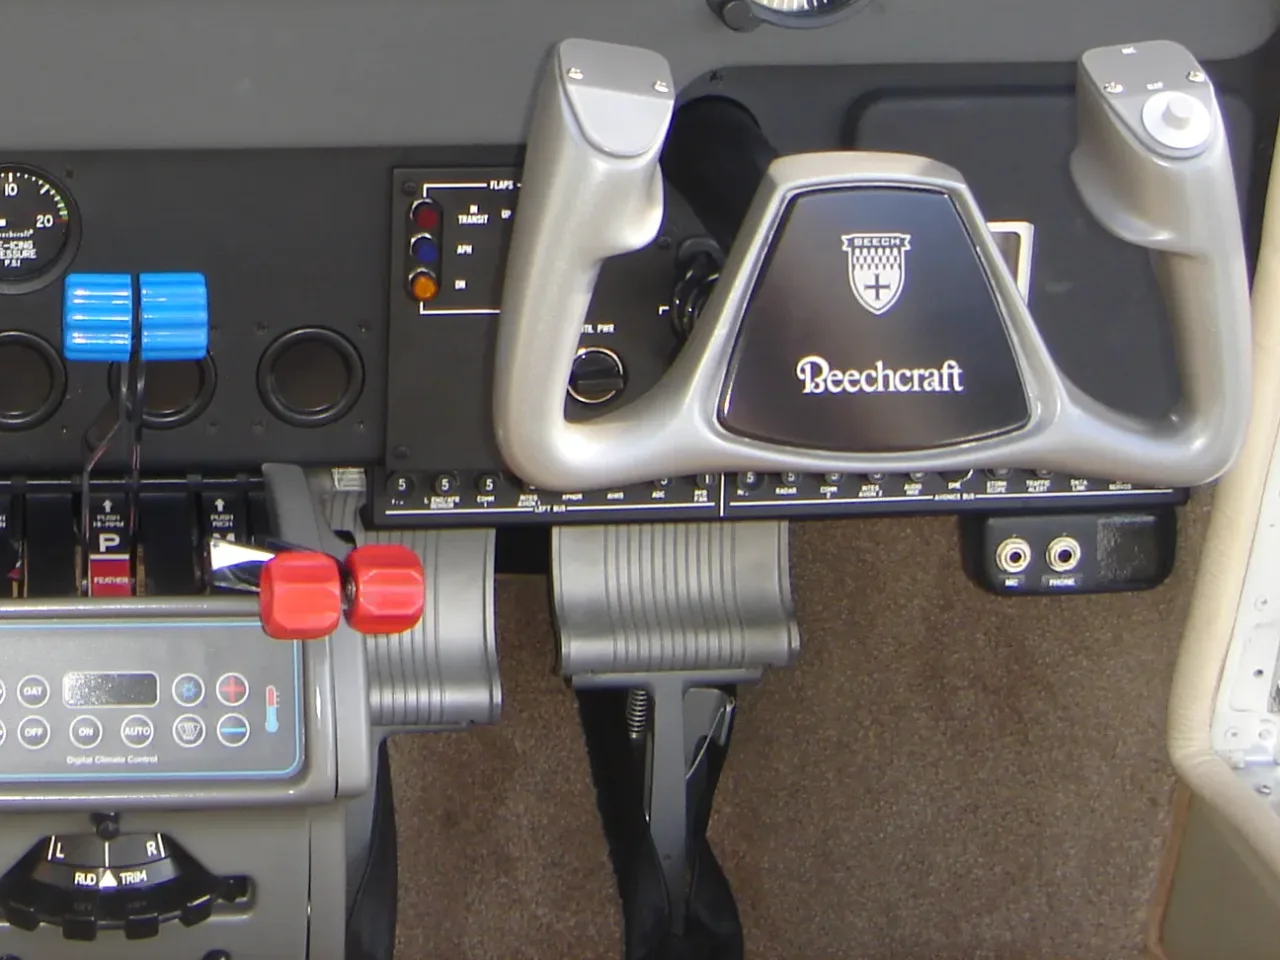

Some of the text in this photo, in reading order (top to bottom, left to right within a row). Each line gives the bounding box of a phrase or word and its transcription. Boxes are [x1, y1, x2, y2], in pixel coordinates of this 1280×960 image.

[4, 184, 17, 195] 10
[490, 180, 513, 190] FLAPS
[36, 215, 53, 227] 20
[458, 215, 488, 224] TRANSIT
[854, 238, 900, 246] BEECH
[598, 324, 614, 333] PWR
[796, 356, 964, 393] Beechcraft
[747, 472, 754, 482] 5
[398, 479, 406, 490] 5
[441, 479, 449, 490] 5
[485, 479, 493, 490] 5
[99, 533, 120, 552] P
[25, 727, 43, 737] OFF
[78, 727, 93, 736] ON
[124, 726, 151, 736] AUTO
[67, 755, 158, 765] Digital Climate Control
[56, 842, 64, 858] L
[146, 841, 156, 856] R
[75, 871, 147, 885] RUD TRIM
